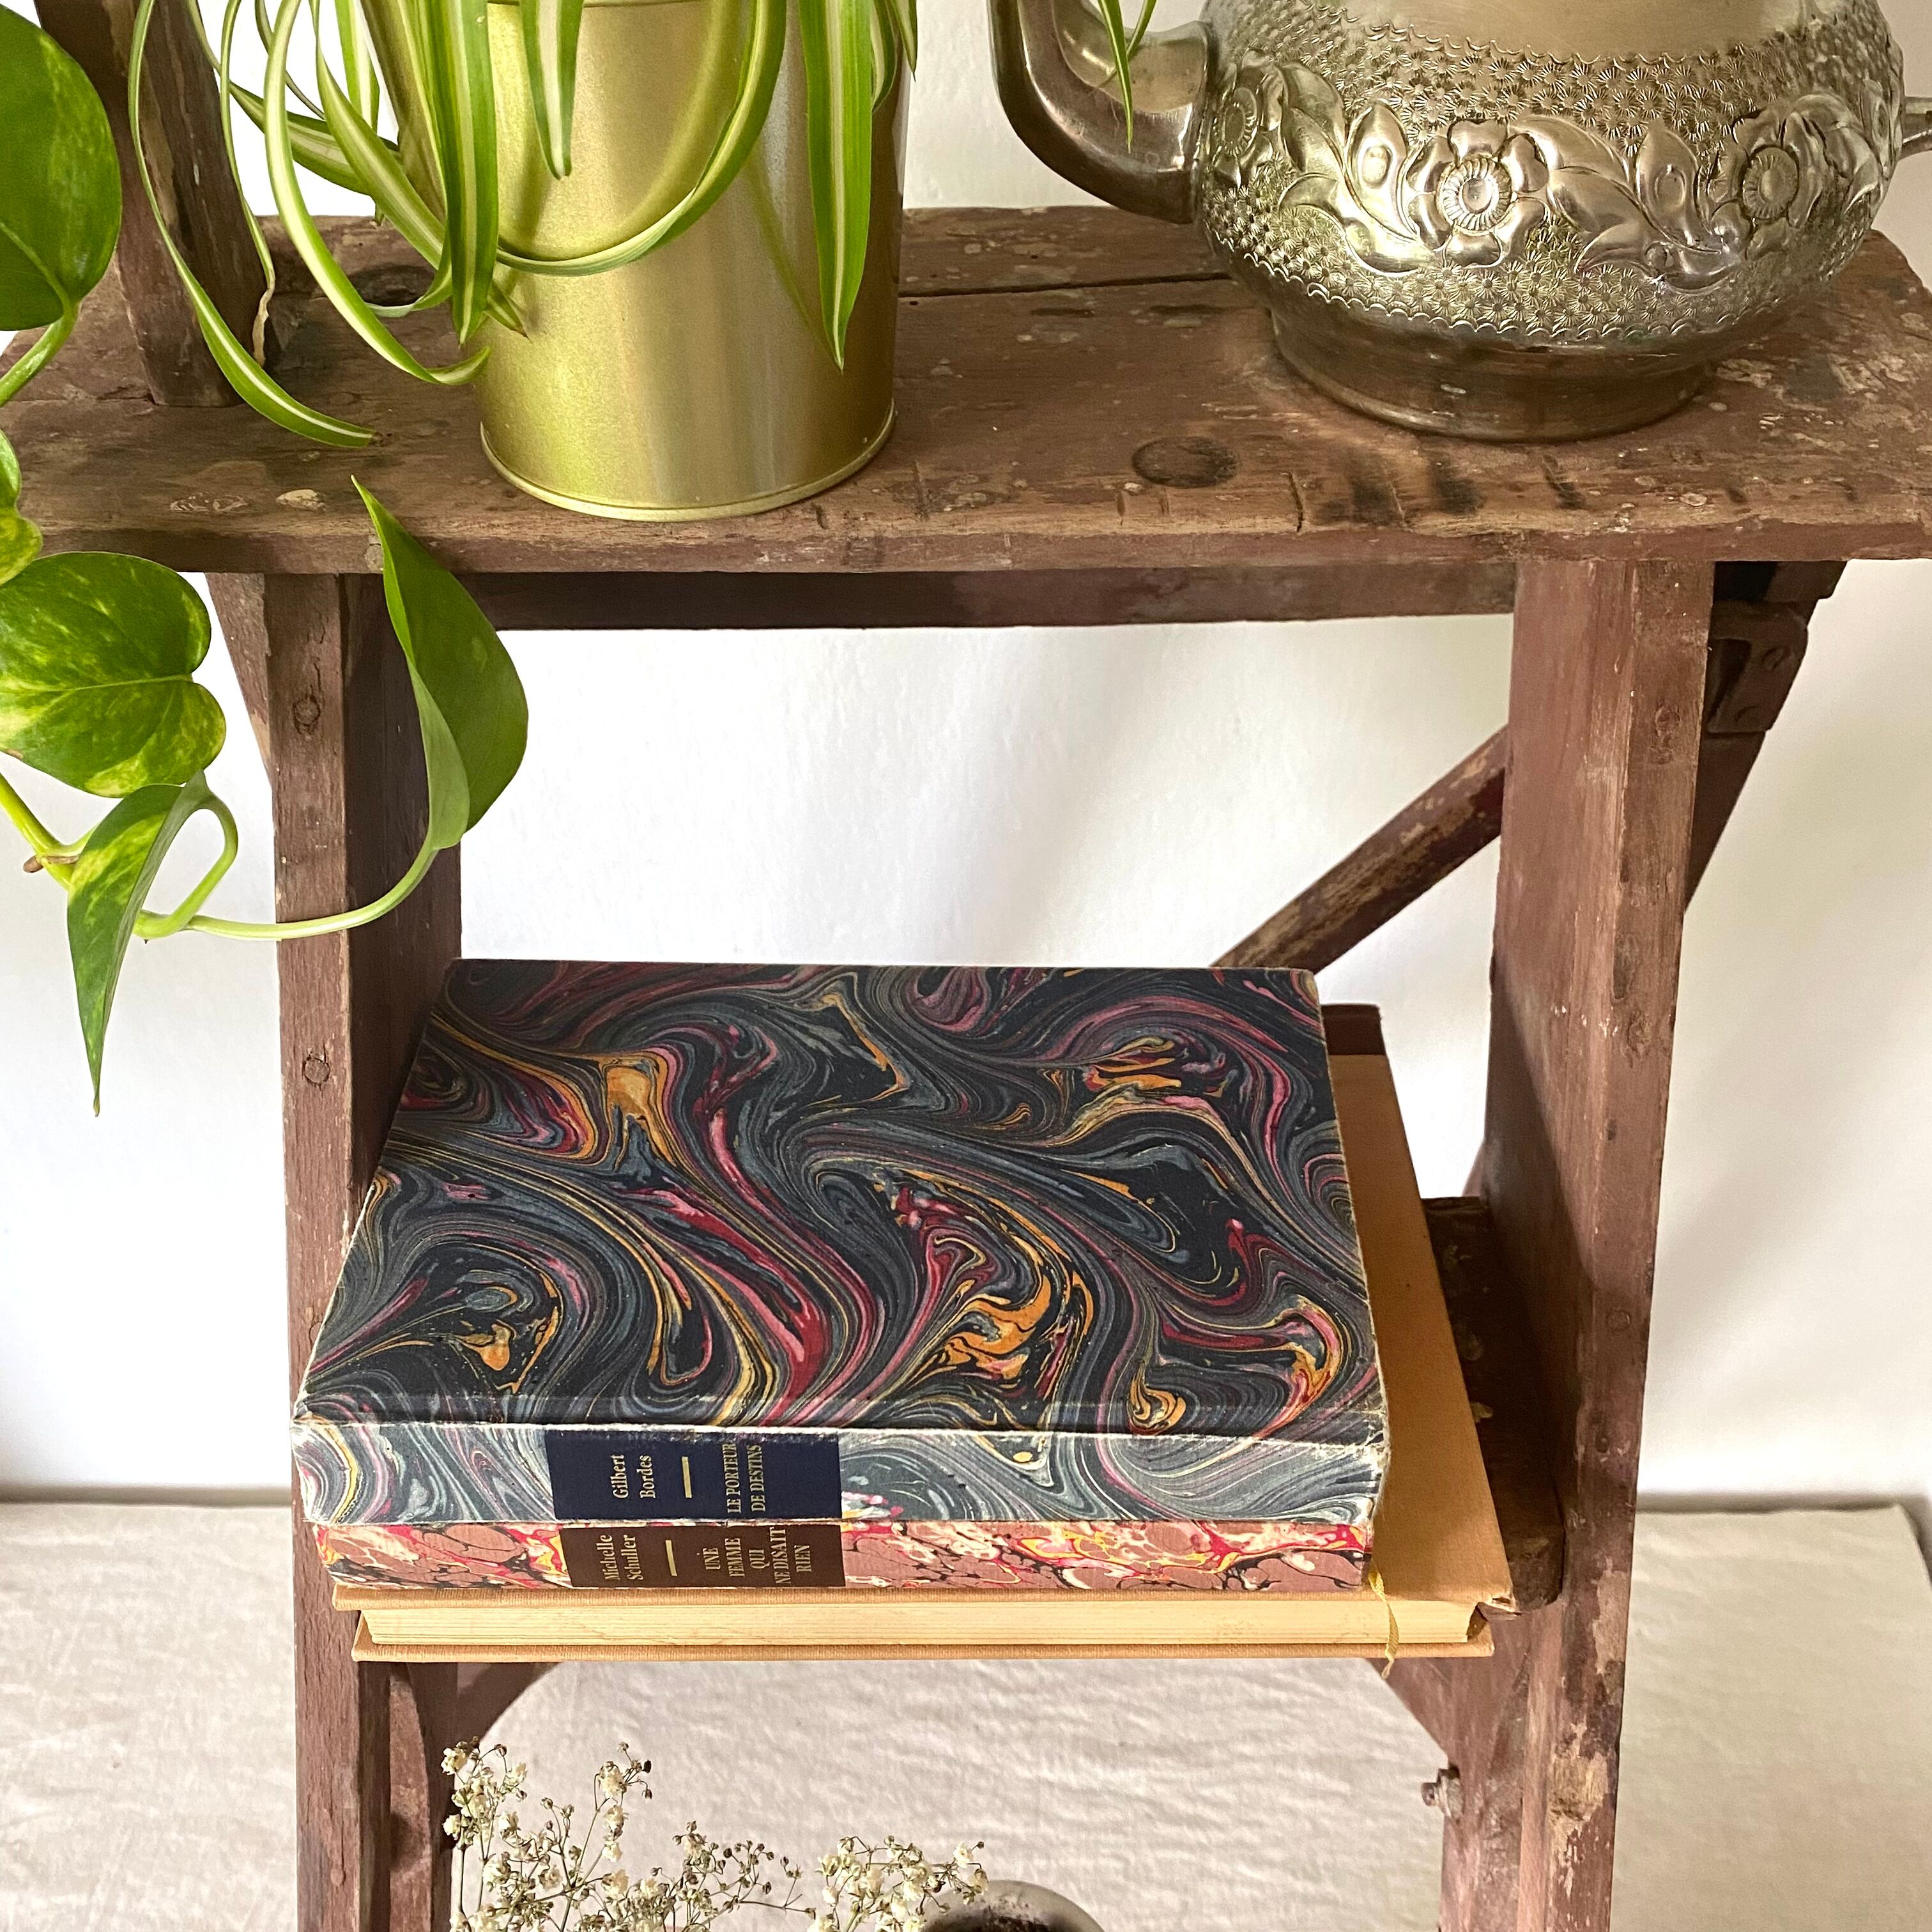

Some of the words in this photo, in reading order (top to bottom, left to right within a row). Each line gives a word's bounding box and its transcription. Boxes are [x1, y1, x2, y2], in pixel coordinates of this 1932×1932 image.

[610, 1454, 629, 1498] Gilbert
[636, 1455, 656, 1498] Bordes
[722, 1443, 740, 1496] PORTEUR
[746, 1445, 765, 1492] DESTINS
[726, 1498, 741, 1514] LE
[750, 1495, 765, 1512] DE
[597, 1534, 620, 1580] Michelle
[621, 1534, 643, 1581] Schuller
[703, 1547, 721, 1570] UNE
[724, 1537, 744, 1577] FEMME
[748, 1548, 770, 1570] QUI
[769, 1526, 789, 1570] DISAIT
[793, 1544, 812, 1572] RIEN
[774, 1570, 792, 1584] NE
